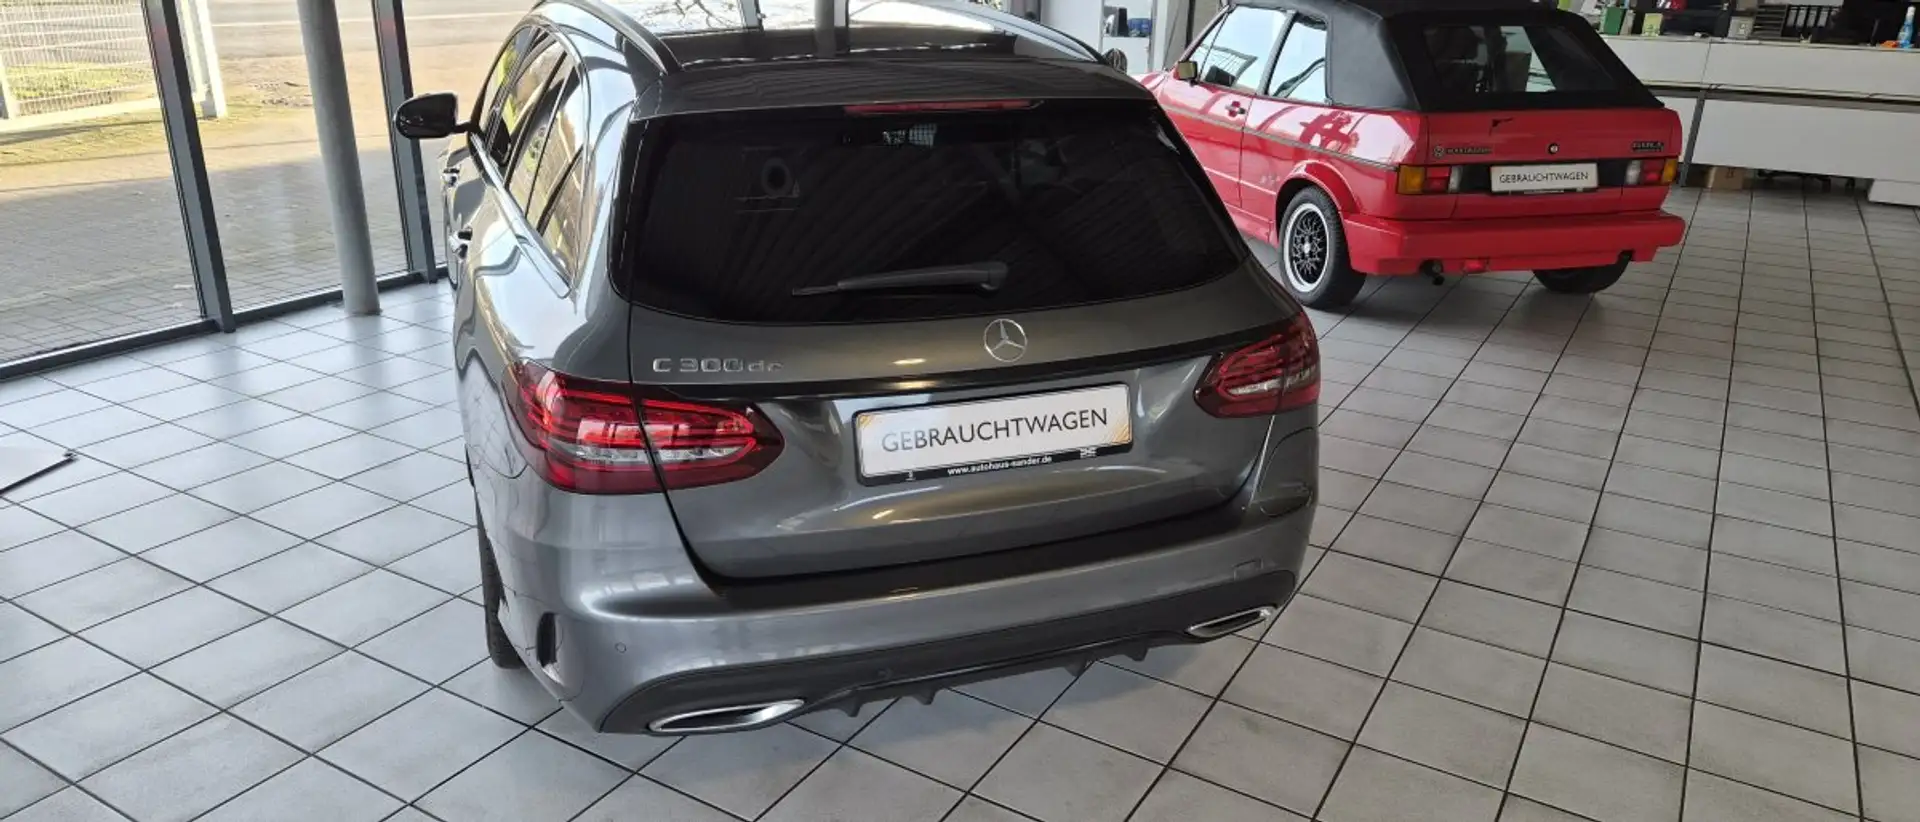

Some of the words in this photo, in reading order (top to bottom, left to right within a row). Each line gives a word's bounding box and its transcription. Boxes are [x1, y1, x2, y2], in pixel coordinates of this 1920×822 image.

[1499, 171, 1589, 184] GEBRAUCHTWAGEN
[652, 358, 672, 373] C
[881, 407, 1108, 452] GEBRAUCHTWAGEN
